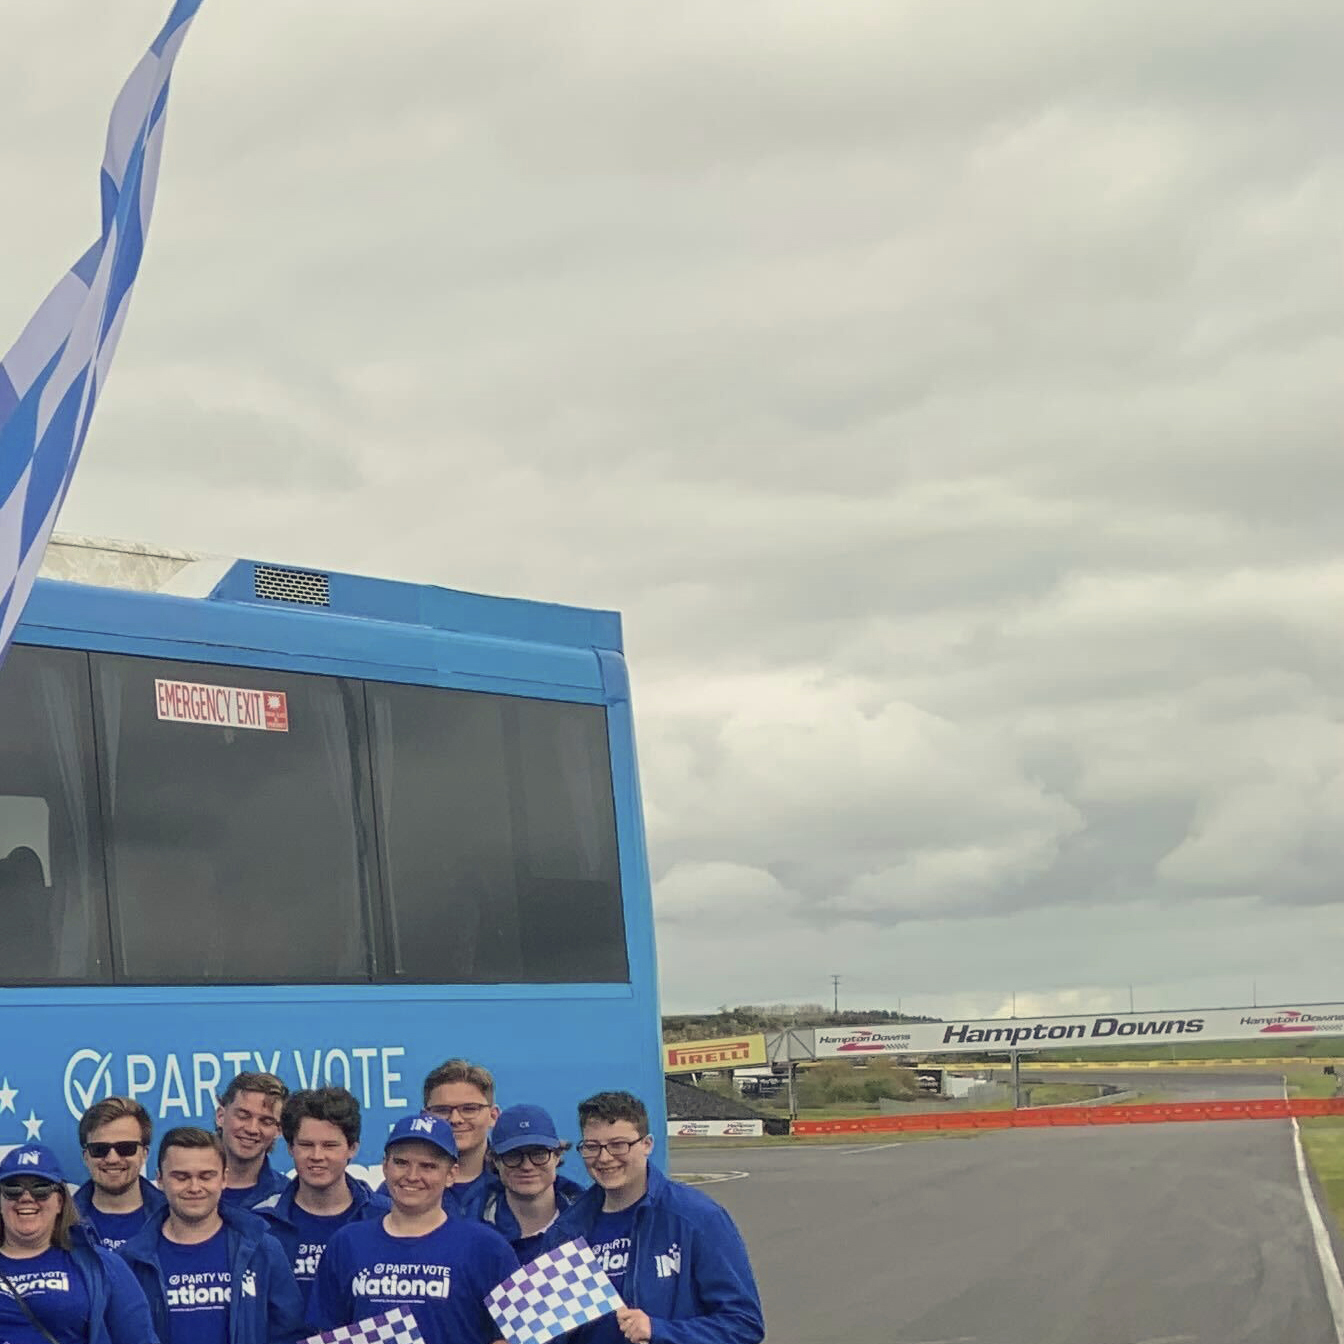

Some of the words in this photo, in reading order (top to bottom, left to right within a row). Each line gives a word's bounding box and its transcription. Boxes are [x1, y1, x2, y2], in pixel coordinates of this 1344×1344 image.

[157, 682, 231, 724] EMERGENCY
[236, 691, 261, 726] EXIT
[819, 1035, 870, 1045] Hampton
[871, 1033, 911, 1042] Downs
[942, 1023, 1086, 1046] Hampton
[1091, 1018, 1204, 1037] Downs
[668, 1042, 750, 1066] PIRELLI
[293, 1047, 408, 1108] VOTE
[182, 1273, 216, 1284] PARTY
[217, 1272, 231, 1282] VO
[386, 1264, 421, 1275] PARTY
[422, 1265, 451, 1277] VOTE
[352, 1274, 451, 1299] National
